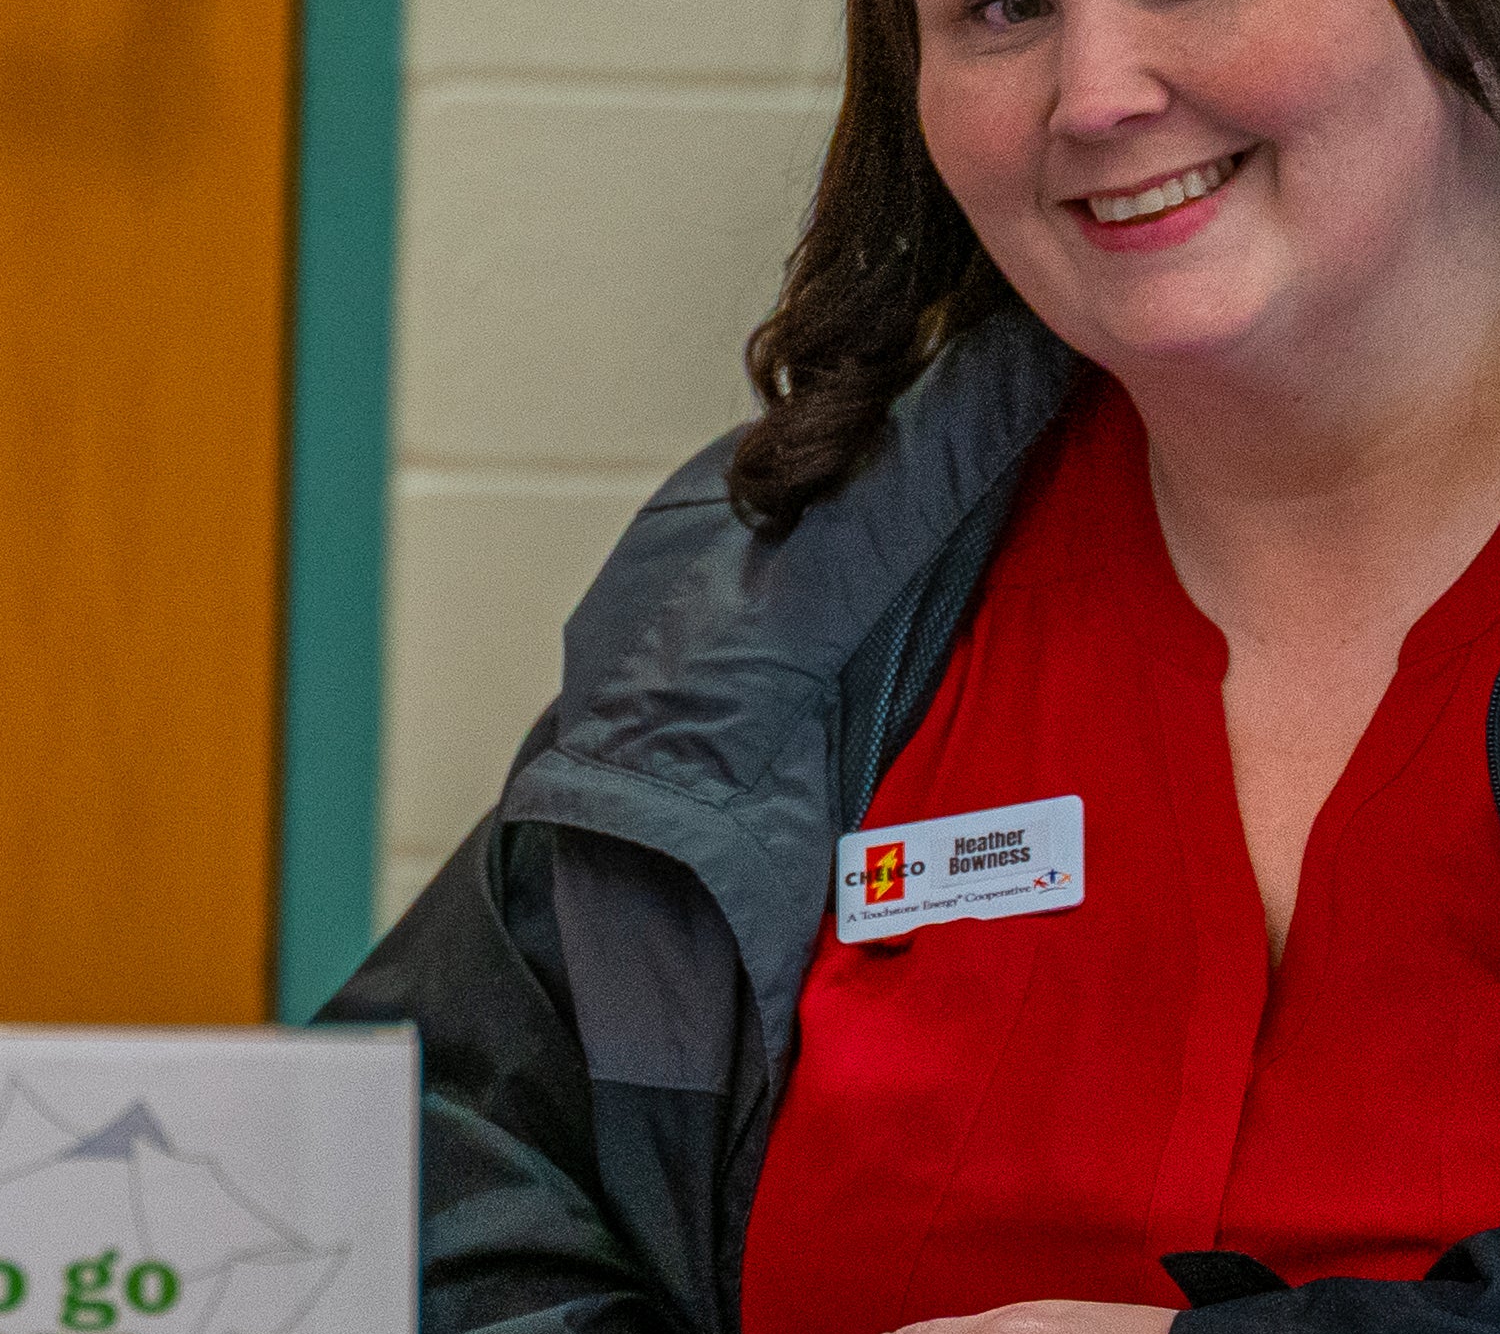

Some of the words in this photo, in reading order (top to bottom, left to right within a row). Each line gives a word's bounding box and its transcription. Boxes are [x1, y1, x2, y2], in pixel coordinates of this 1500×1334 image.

[954, 829, 1025, 855] Heather
[845, 862, 925, 886] CHELCO
[949, 847, 1030, 875] Bowness
[861, 901, 918, 920] Touchstone
[965, 886, 1031, 903] Cooperative
[60, 1247, 180, 1329] go
